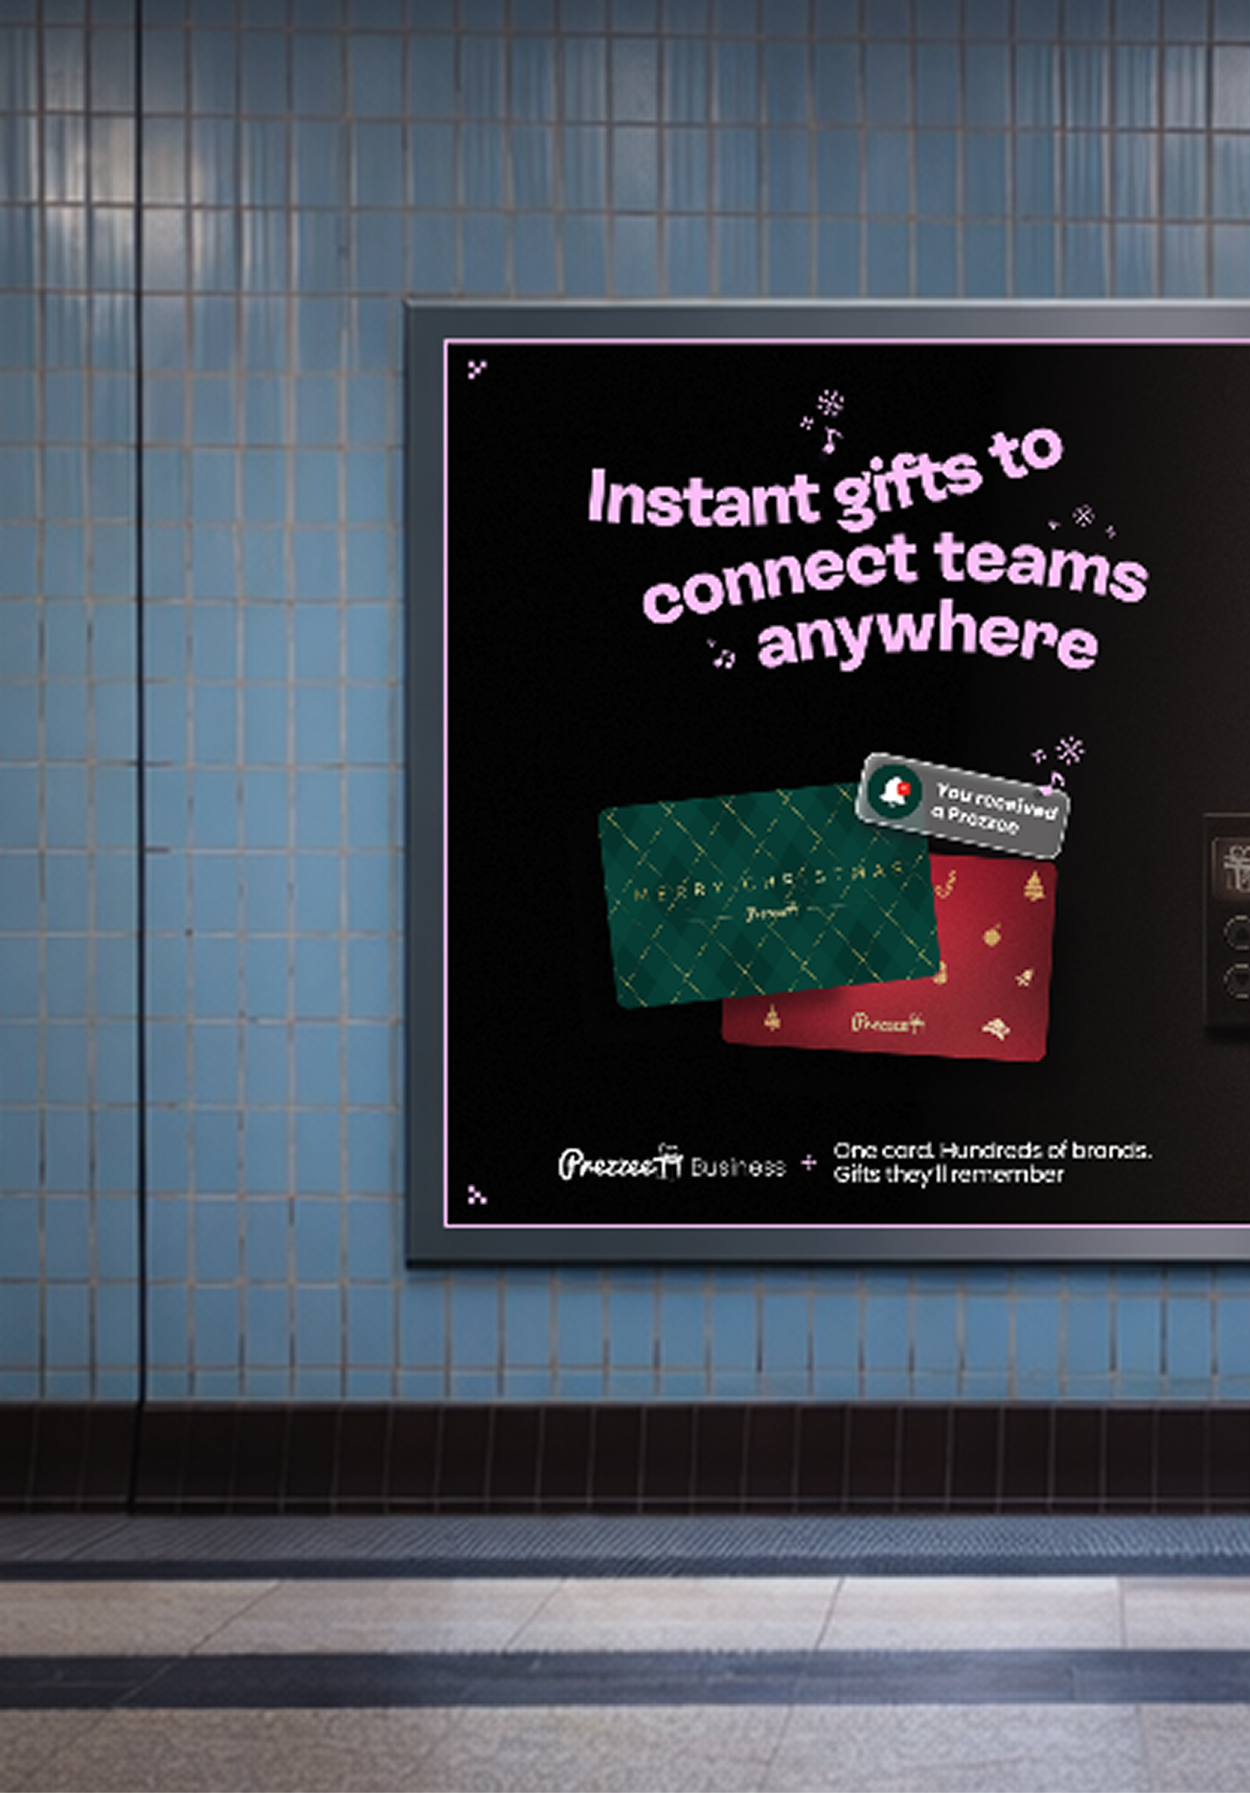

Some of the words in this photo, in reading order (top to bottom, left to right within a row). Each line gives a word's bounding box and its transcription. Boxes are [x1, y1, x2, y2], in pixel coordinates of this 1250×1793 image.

[588, 468, 821, 527] Instant
[834, 453, 983, 533] gifts
[988, 428, 1064, 479] to
[643, 533, 918, 625] connect
[934, 532, 1150, 604] teams
[757, 598, 1099, 672] anywhere
[936, 782, 972, 803] You
[634, 881, 724, 901] MERRY
[833, 1142, 878, 1159] One
[939, 1141, 1043, 1159] Hundreds
[1048, 1139, 1068, 1159] of
[1072, 1141, 1153, 1159] brands.
[559, 1148, 660, 1181] Prezzee
[691, 1157, 787, 1177] Business
[833, 1163, 881, 1183] Gifts
[951, 1164, 1065, 1183] remember
